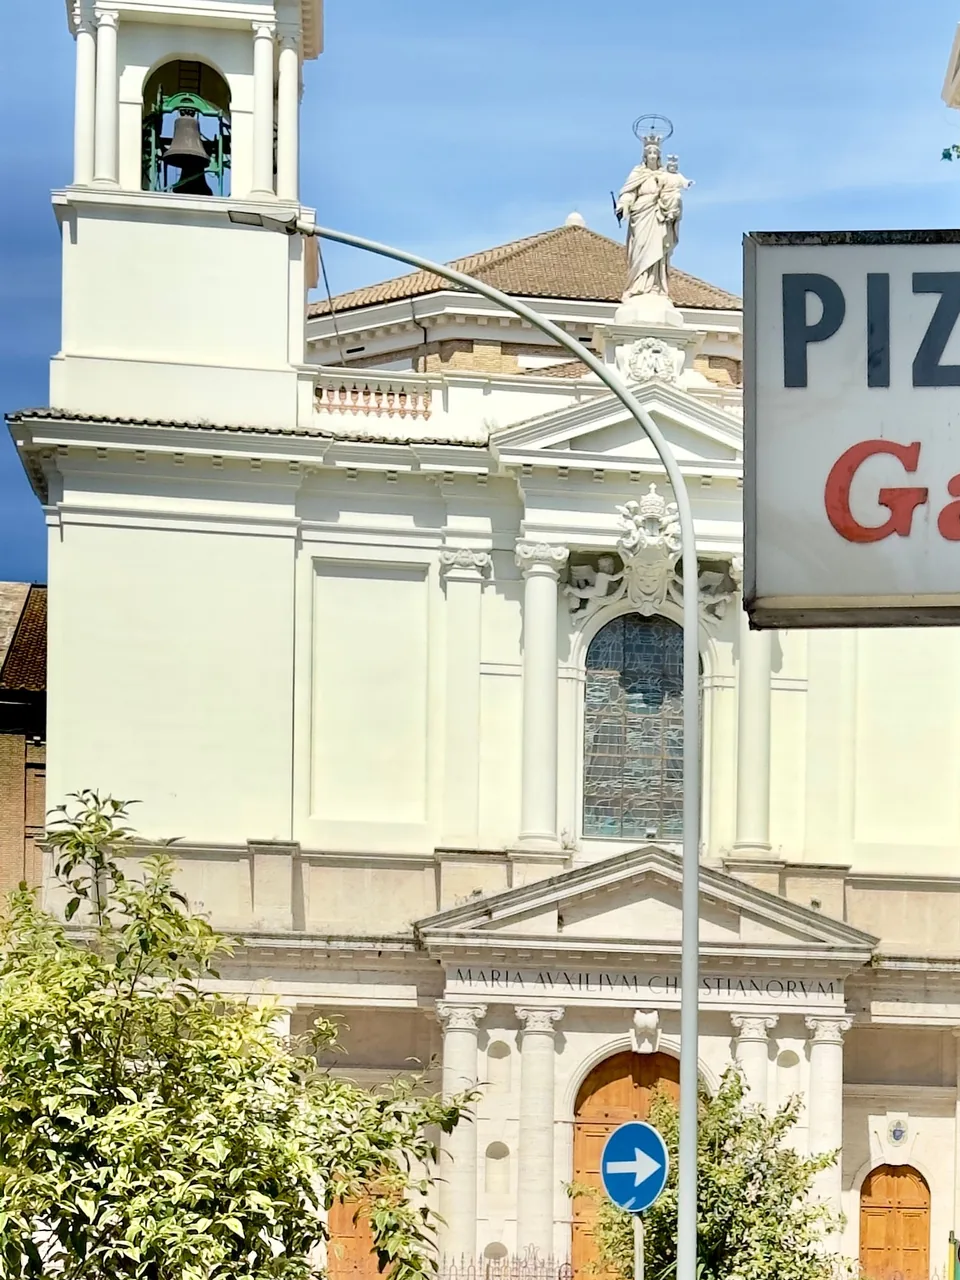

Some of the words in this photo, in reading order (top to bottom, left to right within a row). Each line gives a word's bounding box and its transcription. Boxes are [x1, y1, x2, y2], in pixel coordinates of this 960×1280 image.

[455, 968, 525, 989] MARIA
[534, 971, 639, 994] AVXILIVM
[647, 975, 835, 1000] CHSTIANORVM
